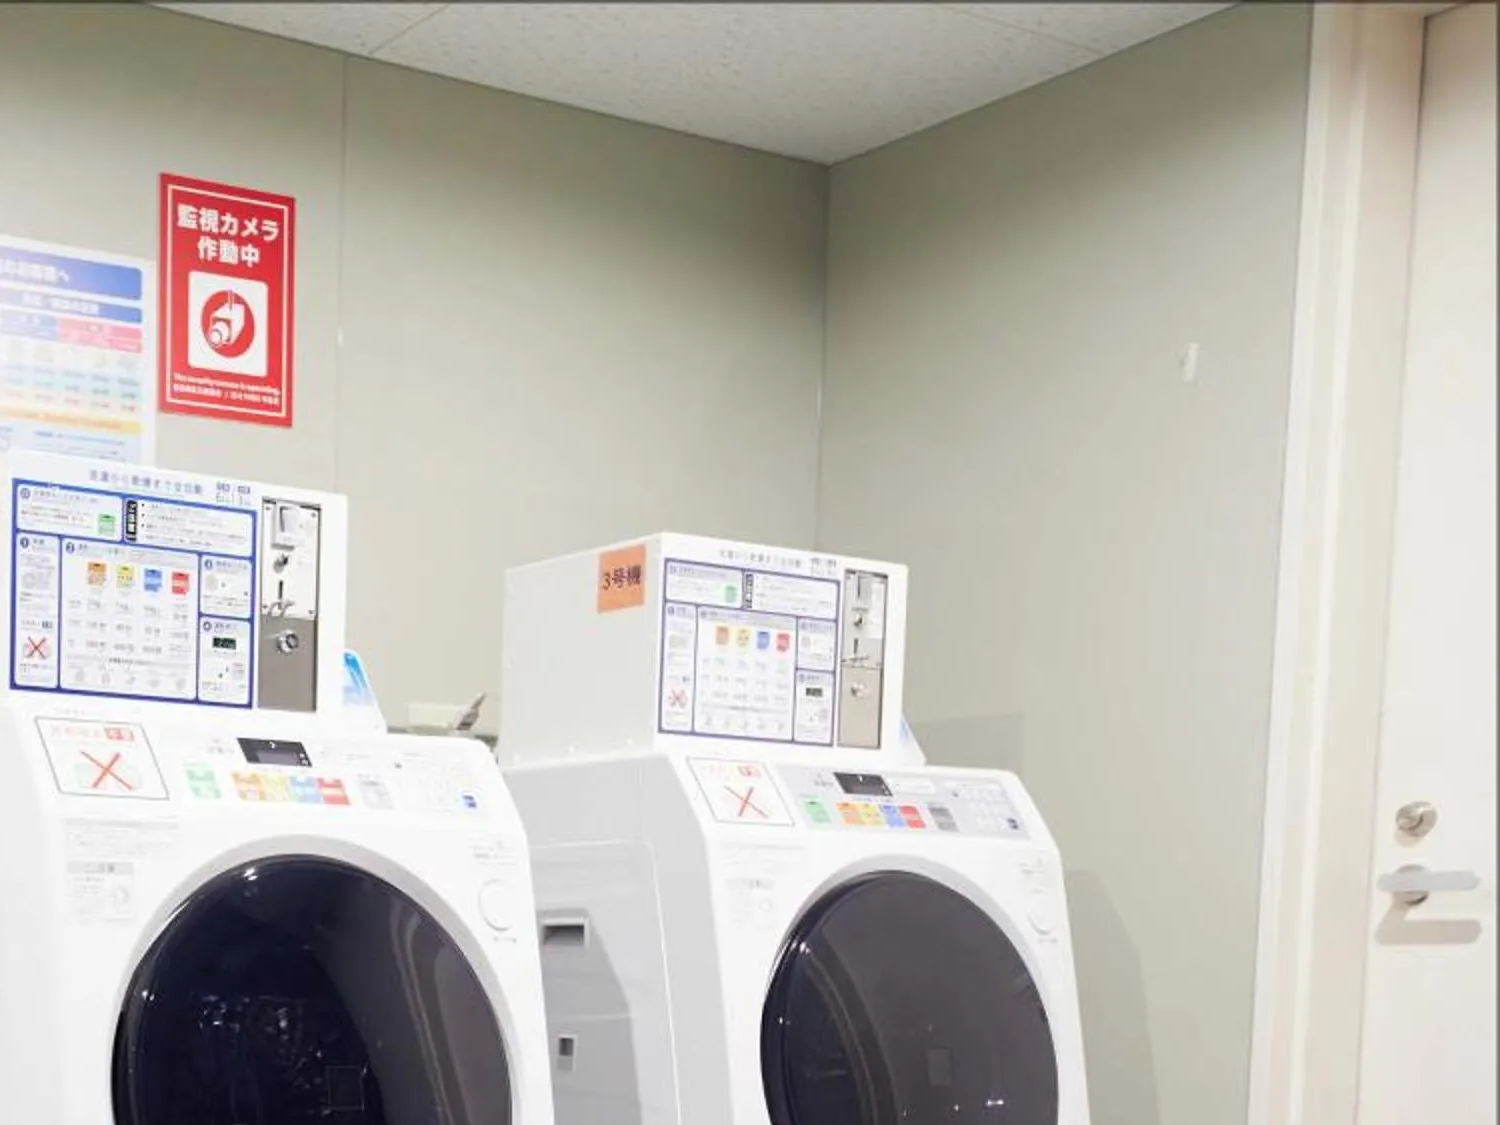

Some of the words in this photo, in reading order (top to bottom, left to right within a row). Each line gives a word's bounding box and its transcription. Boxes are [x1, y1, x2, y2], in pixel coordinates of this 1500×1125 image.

[177, 203, 279, 242] 監視カメラ
[197, 236, 260, 268] 作動中
[602, 565, 642, 590] 3号機
